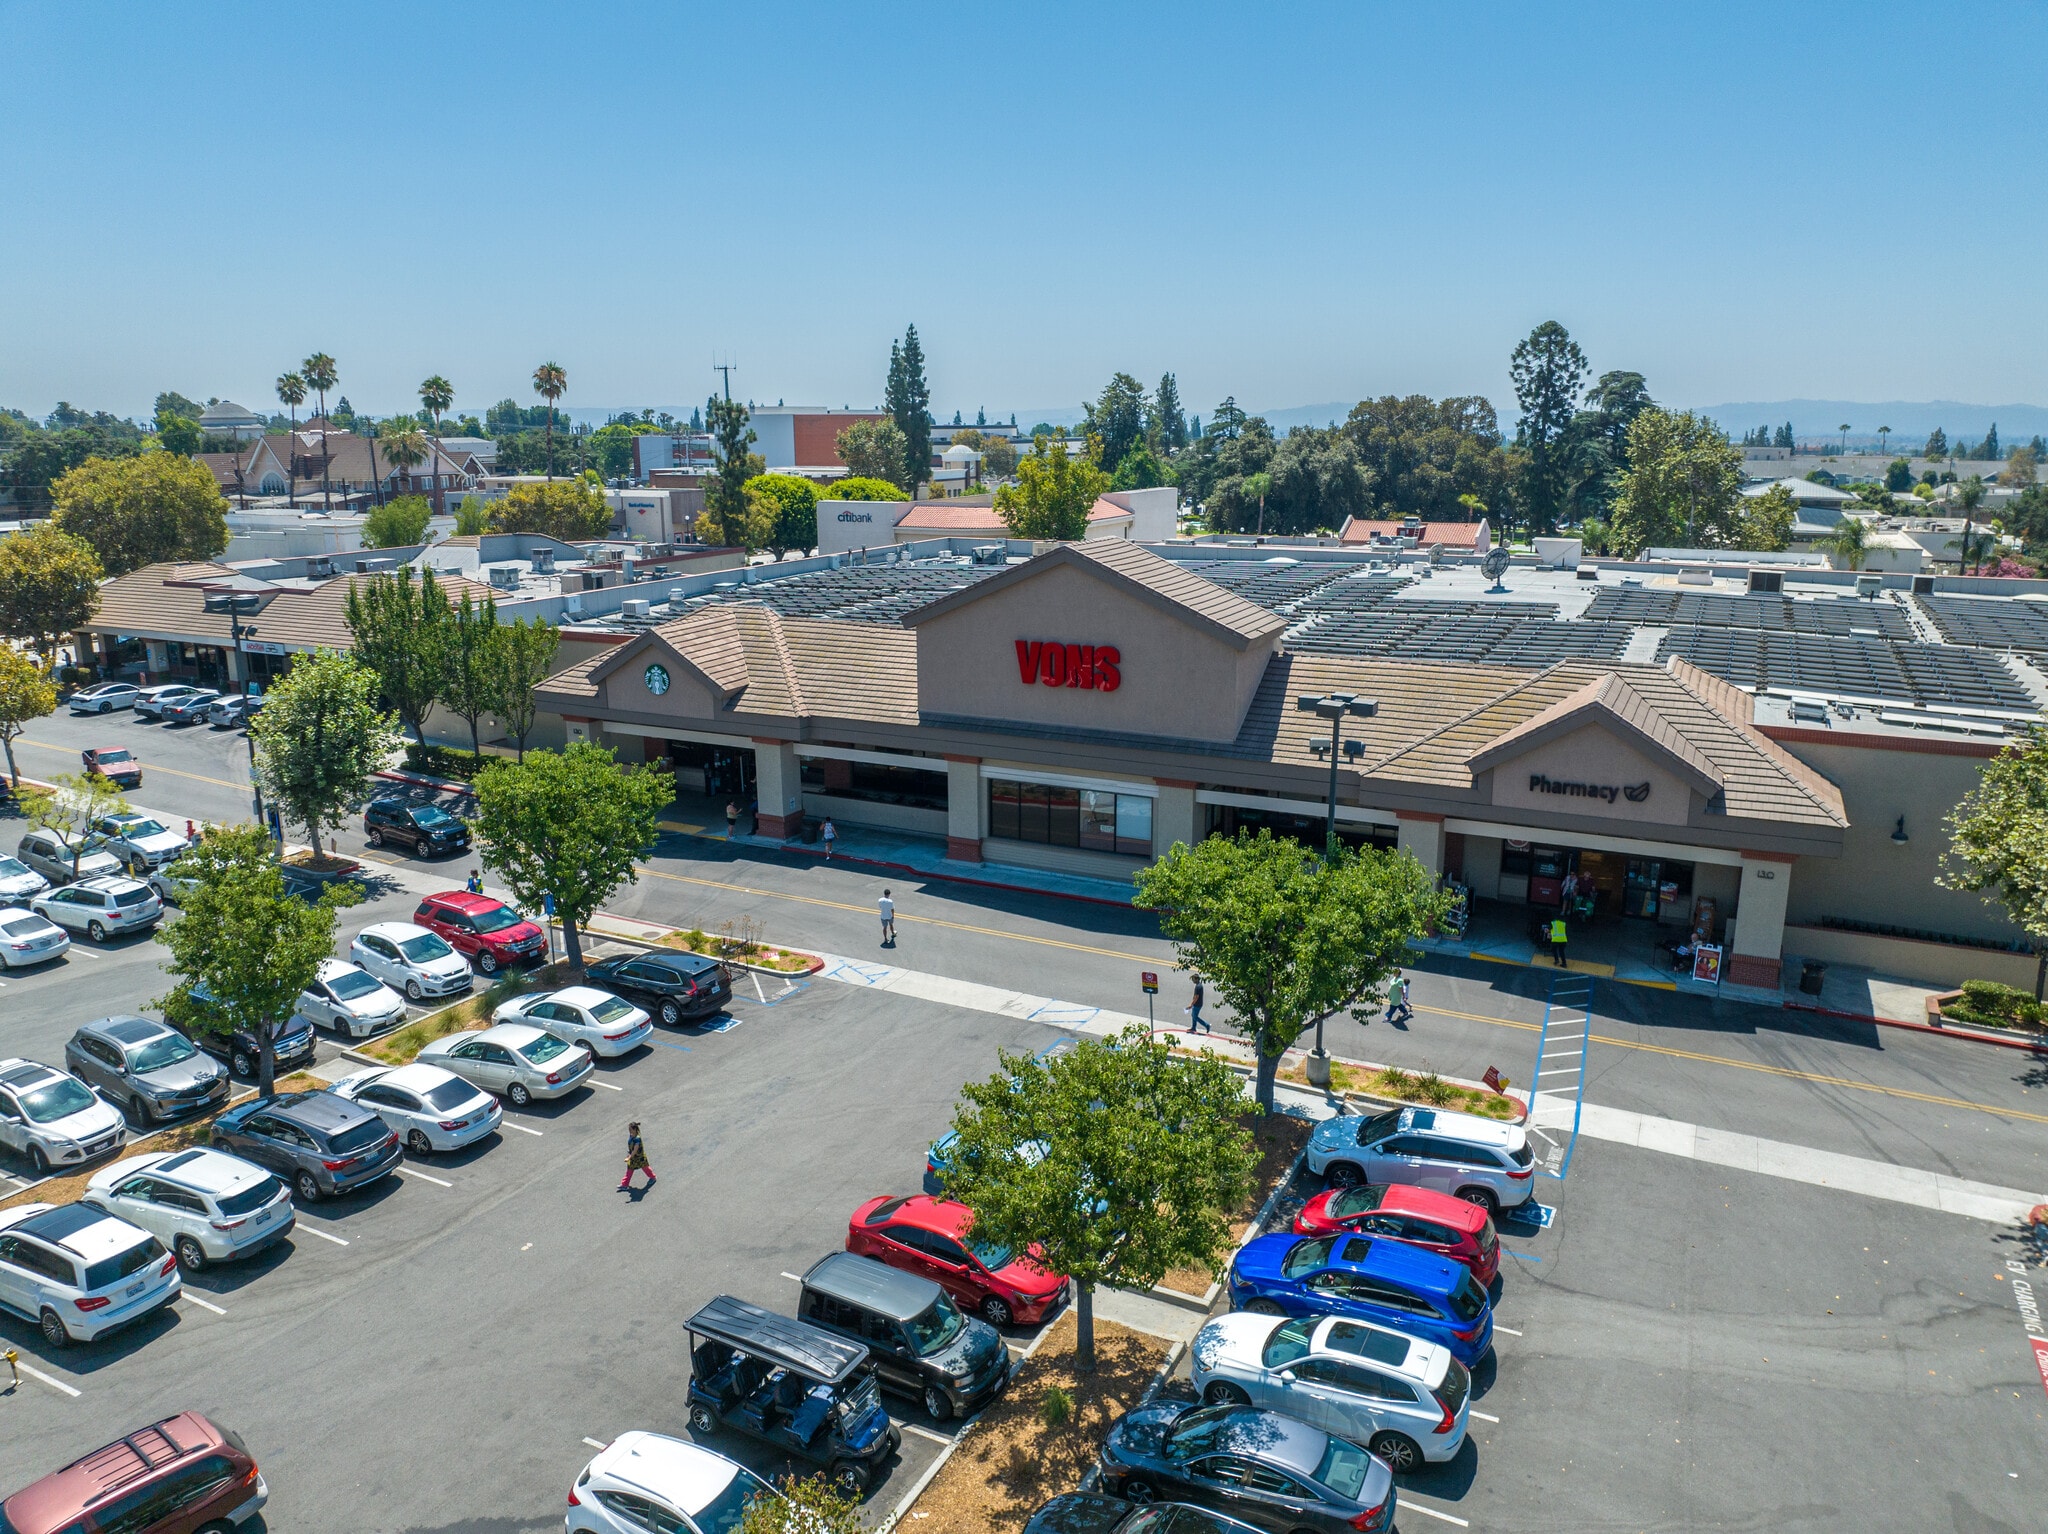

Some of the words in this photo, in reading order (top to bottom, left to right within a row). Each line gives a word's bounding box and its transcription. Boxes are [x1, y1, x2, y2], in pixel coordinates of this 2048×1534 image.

[837, 511, 873, 523] citibank
[1014, 639, 1121, 692] VONS
[1529, 774, 1619, 804] Pharmacy
[2006, 1260, 2028, 1276] EV
[2012, 1279, 2044, 1333] CHARGING
